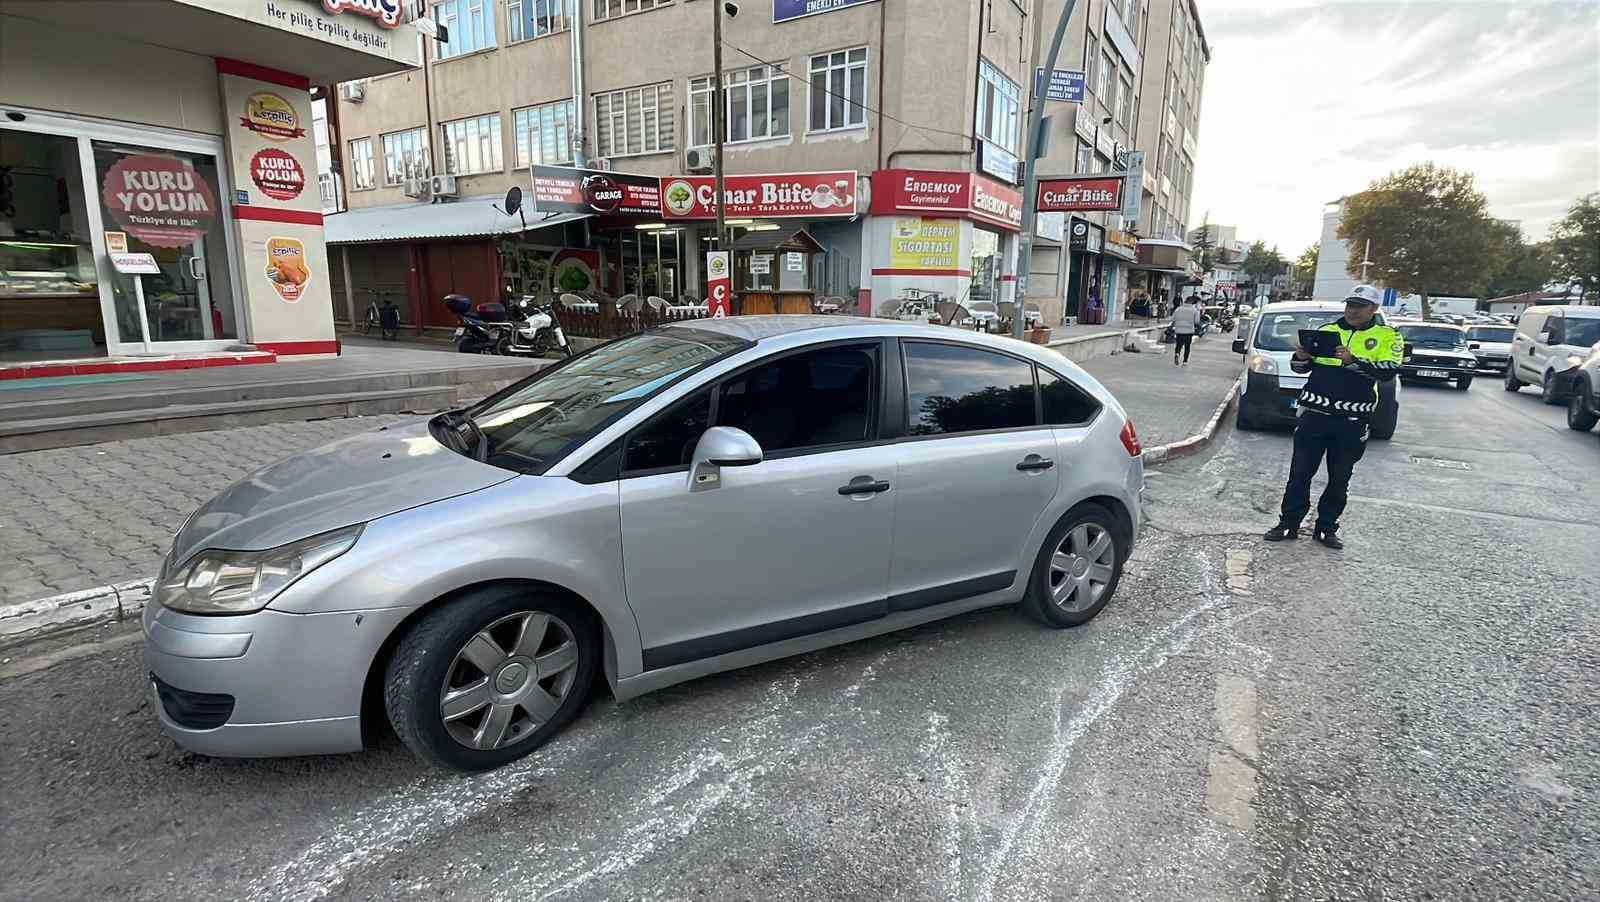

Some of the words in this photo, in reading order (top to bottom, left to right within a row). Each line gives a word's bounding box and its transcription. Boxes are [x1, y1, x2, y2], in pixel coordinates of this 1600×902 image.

[267, 3, 286, 19] Her
[290, 12, 314, 31] piliç
[317, 17, 350, 41] Erpiliç
[352, 29, 386, 49] değildir
[260, 157, 295, 170] KURU
[122, 170, 195, 191] KURU
[256, 169, 302, 181] YOLUM
[760, 183, 812, 204] Büfe
[904, 177, 962, 193] ERDEMSOY
[116, 192, 209, 212] YOLUM
[595, 190, 622, 200] GARAGE
[974, 184, 1008, 216] ERDEMSOY
[1044, 191, 1080, 207] Çınar
[1082, 190, 1113, 202] Büfe
